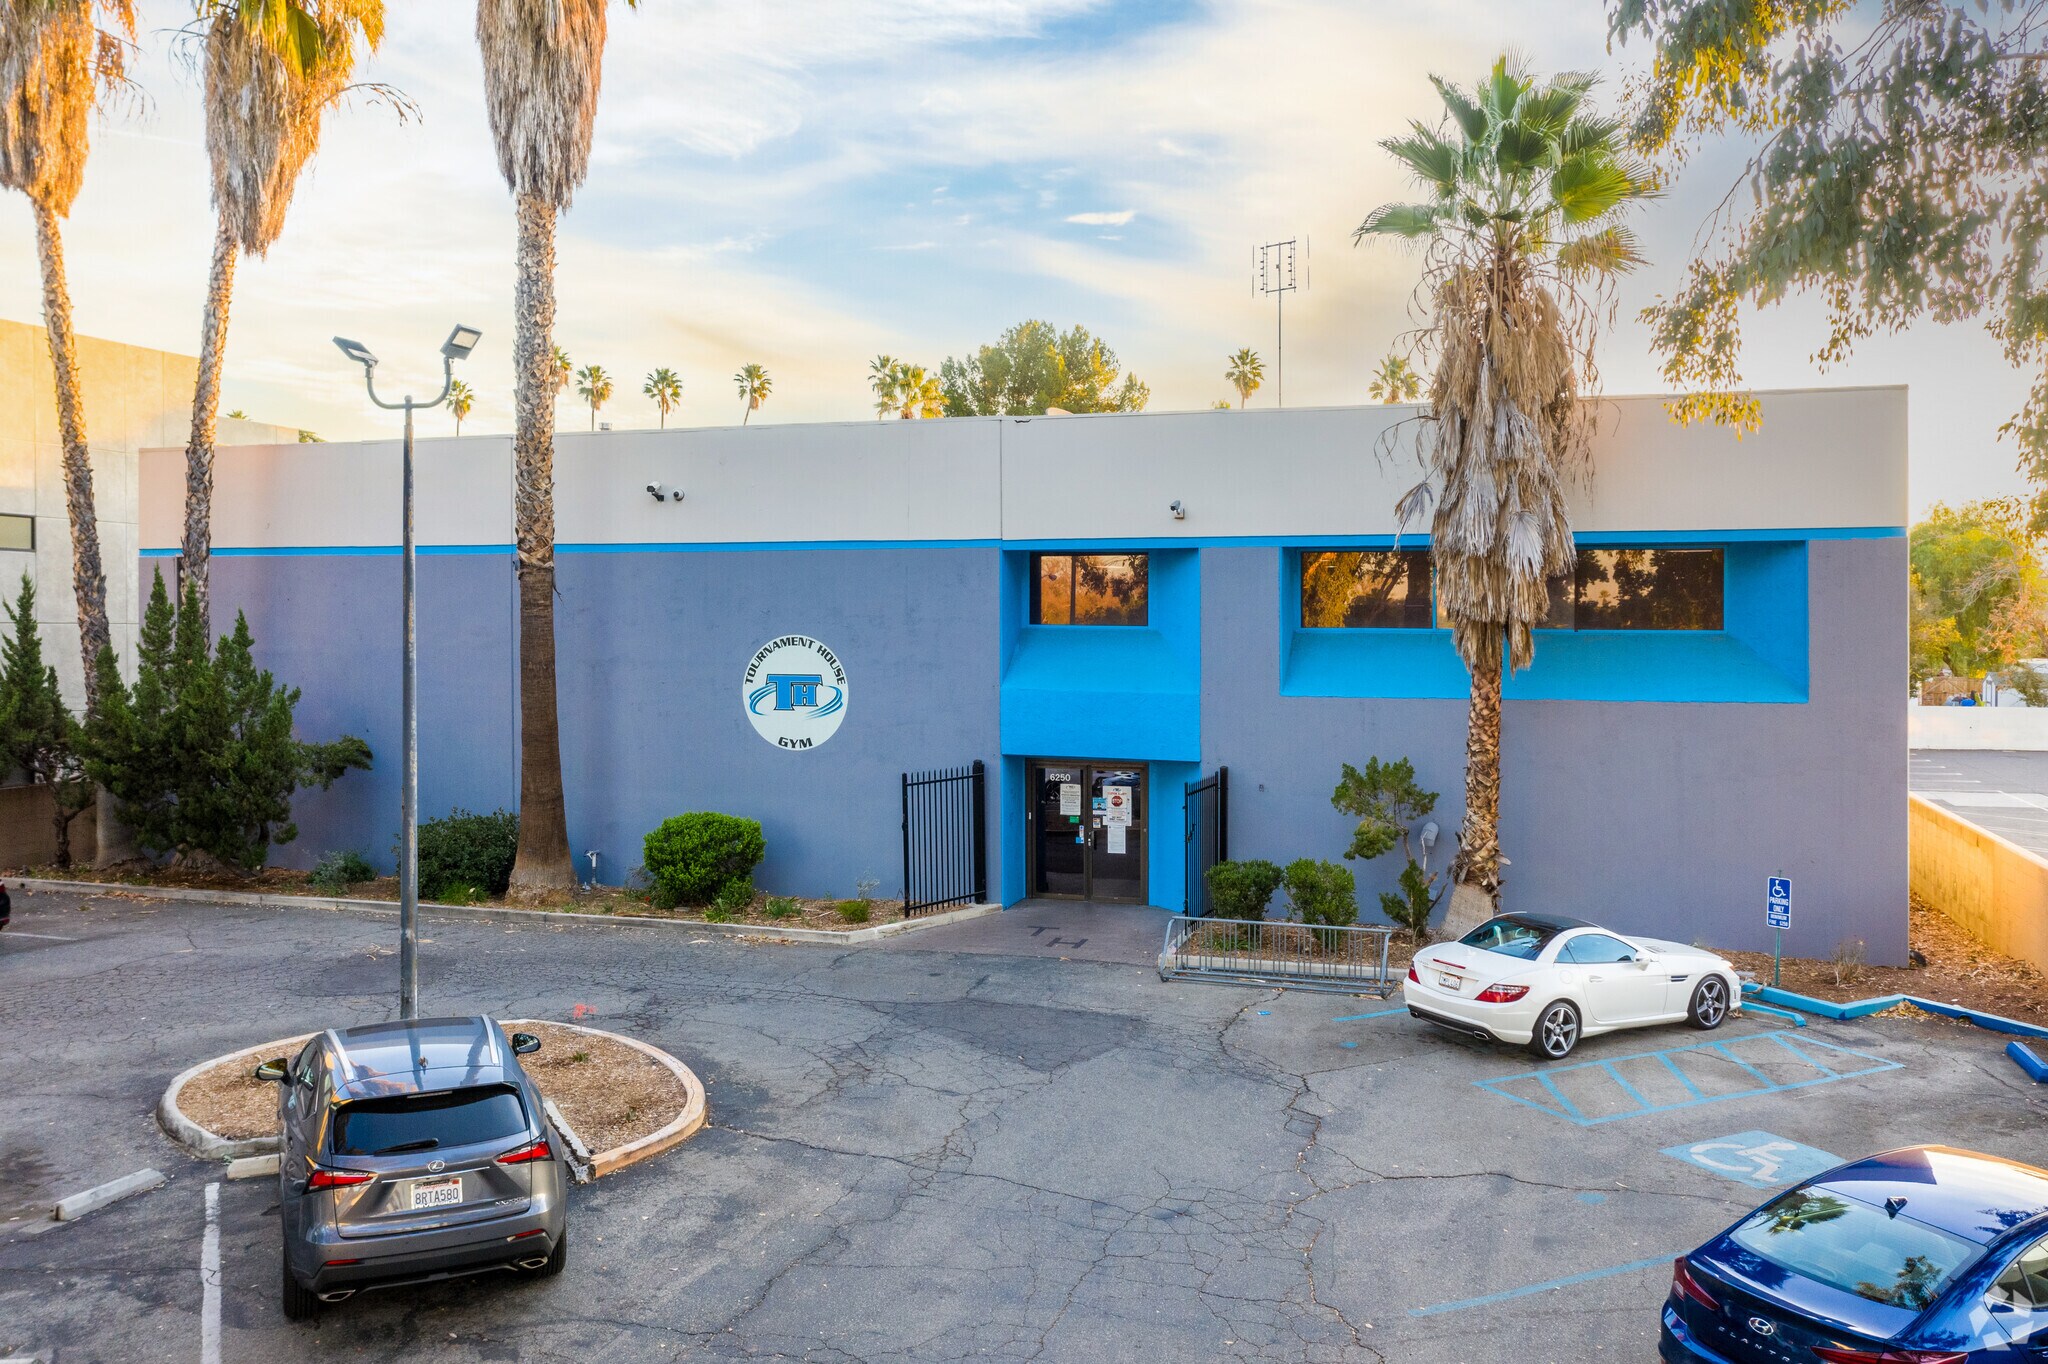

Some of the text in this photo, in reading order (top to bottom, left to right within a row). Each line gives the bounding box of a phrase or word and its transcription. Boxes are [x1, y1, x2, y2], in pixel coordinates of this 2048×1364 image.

[745, 637, 846, 685] TOURNAMENT HOUSE
[765, 674, 823, 711] TH
[778, 737, 813, 749] GYM
[1050, 773, 1071, 782] 6250
[1770, 897, 1789, 906] PARKING
[1773, 905, 1785, 913] ONLY
[415, 1187, 459, 1205] 8RTA580
[1718, 1326, 1804, 1364] ELANTR
